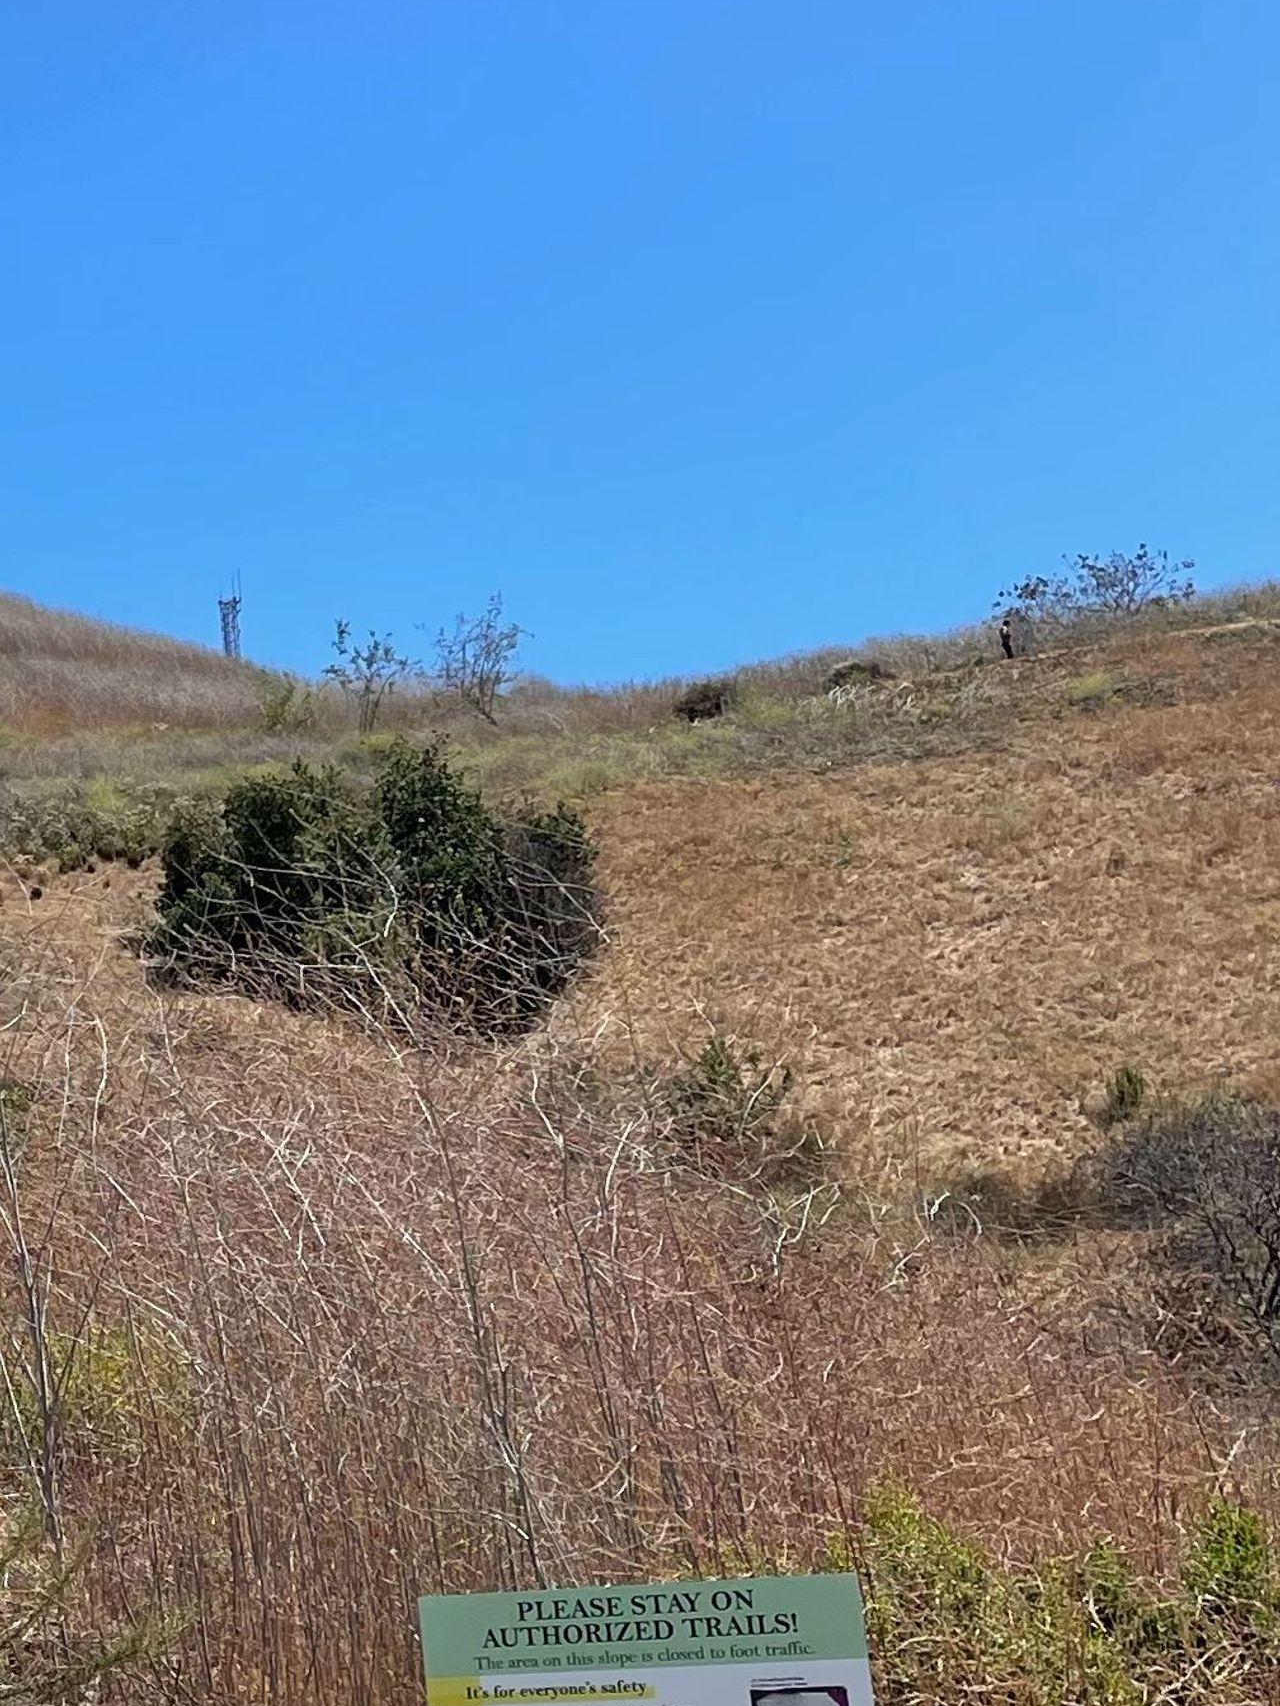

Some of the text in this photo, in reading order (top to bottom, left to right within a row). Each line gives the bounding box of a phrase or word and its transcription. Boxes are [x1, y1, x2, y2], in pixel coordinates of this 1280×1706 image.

[517, 1589, 754, 1621] PLEASE STAY ON
[483, 1612, 799, 1648] AUTHORIZED TRAILS!
[474, 1656, 504, 1670] The
[508, 1656, 540, 1669] area
[543, 1656, 561, 1667] on
[566, 1651, 594, 1666] this
[598, 1649, 636, 1668] slope
[641, 1649, 653, 1662] is
[658, 1646, 704, 1662] closed
[710, 1646, 725, 1659] to
[729, 1642, 761, 1659] foot
[466, 1679, 647, 1700] It's for everyone's safety
